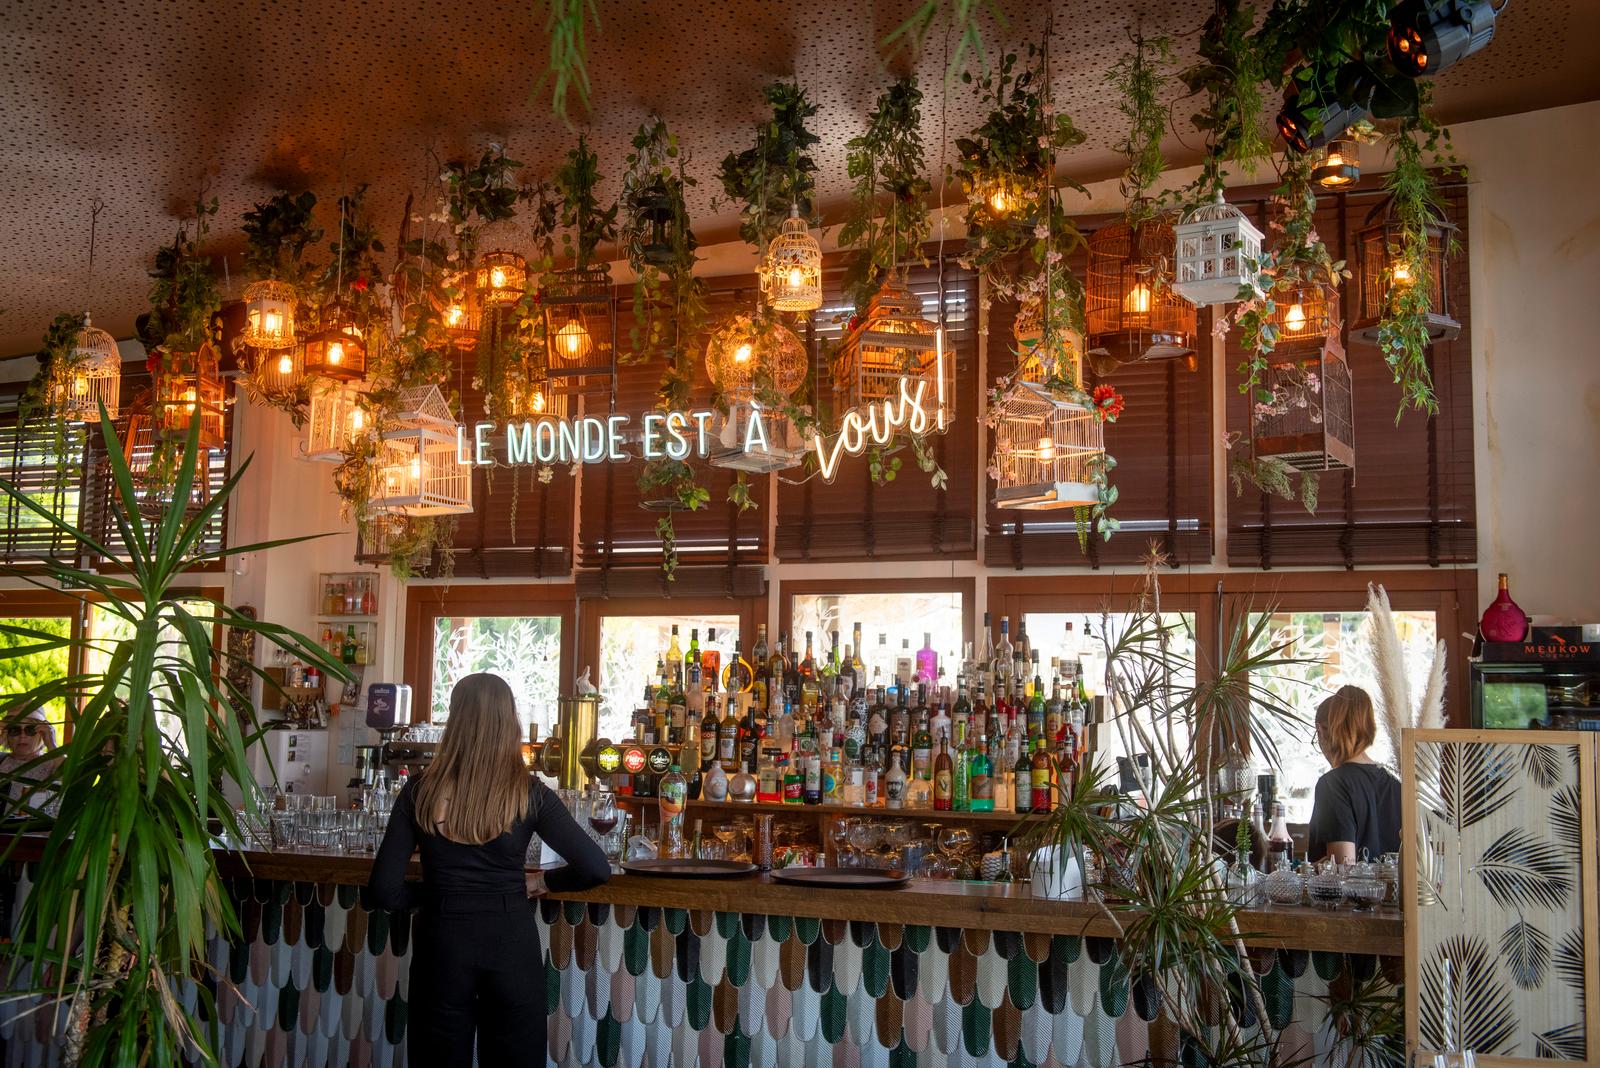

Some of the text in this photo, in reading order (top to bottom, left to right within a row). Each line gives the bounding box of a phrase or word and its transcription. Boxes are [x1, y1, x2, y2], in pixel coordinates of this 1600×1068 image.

[457, 424, 495, 465] LE
[507, 415, 629, 465] MONDE
[643, 411, 713, 459] EST
[744, 400, 769, 453] À
[1525, 645, 1590, 654] MEUKOW
